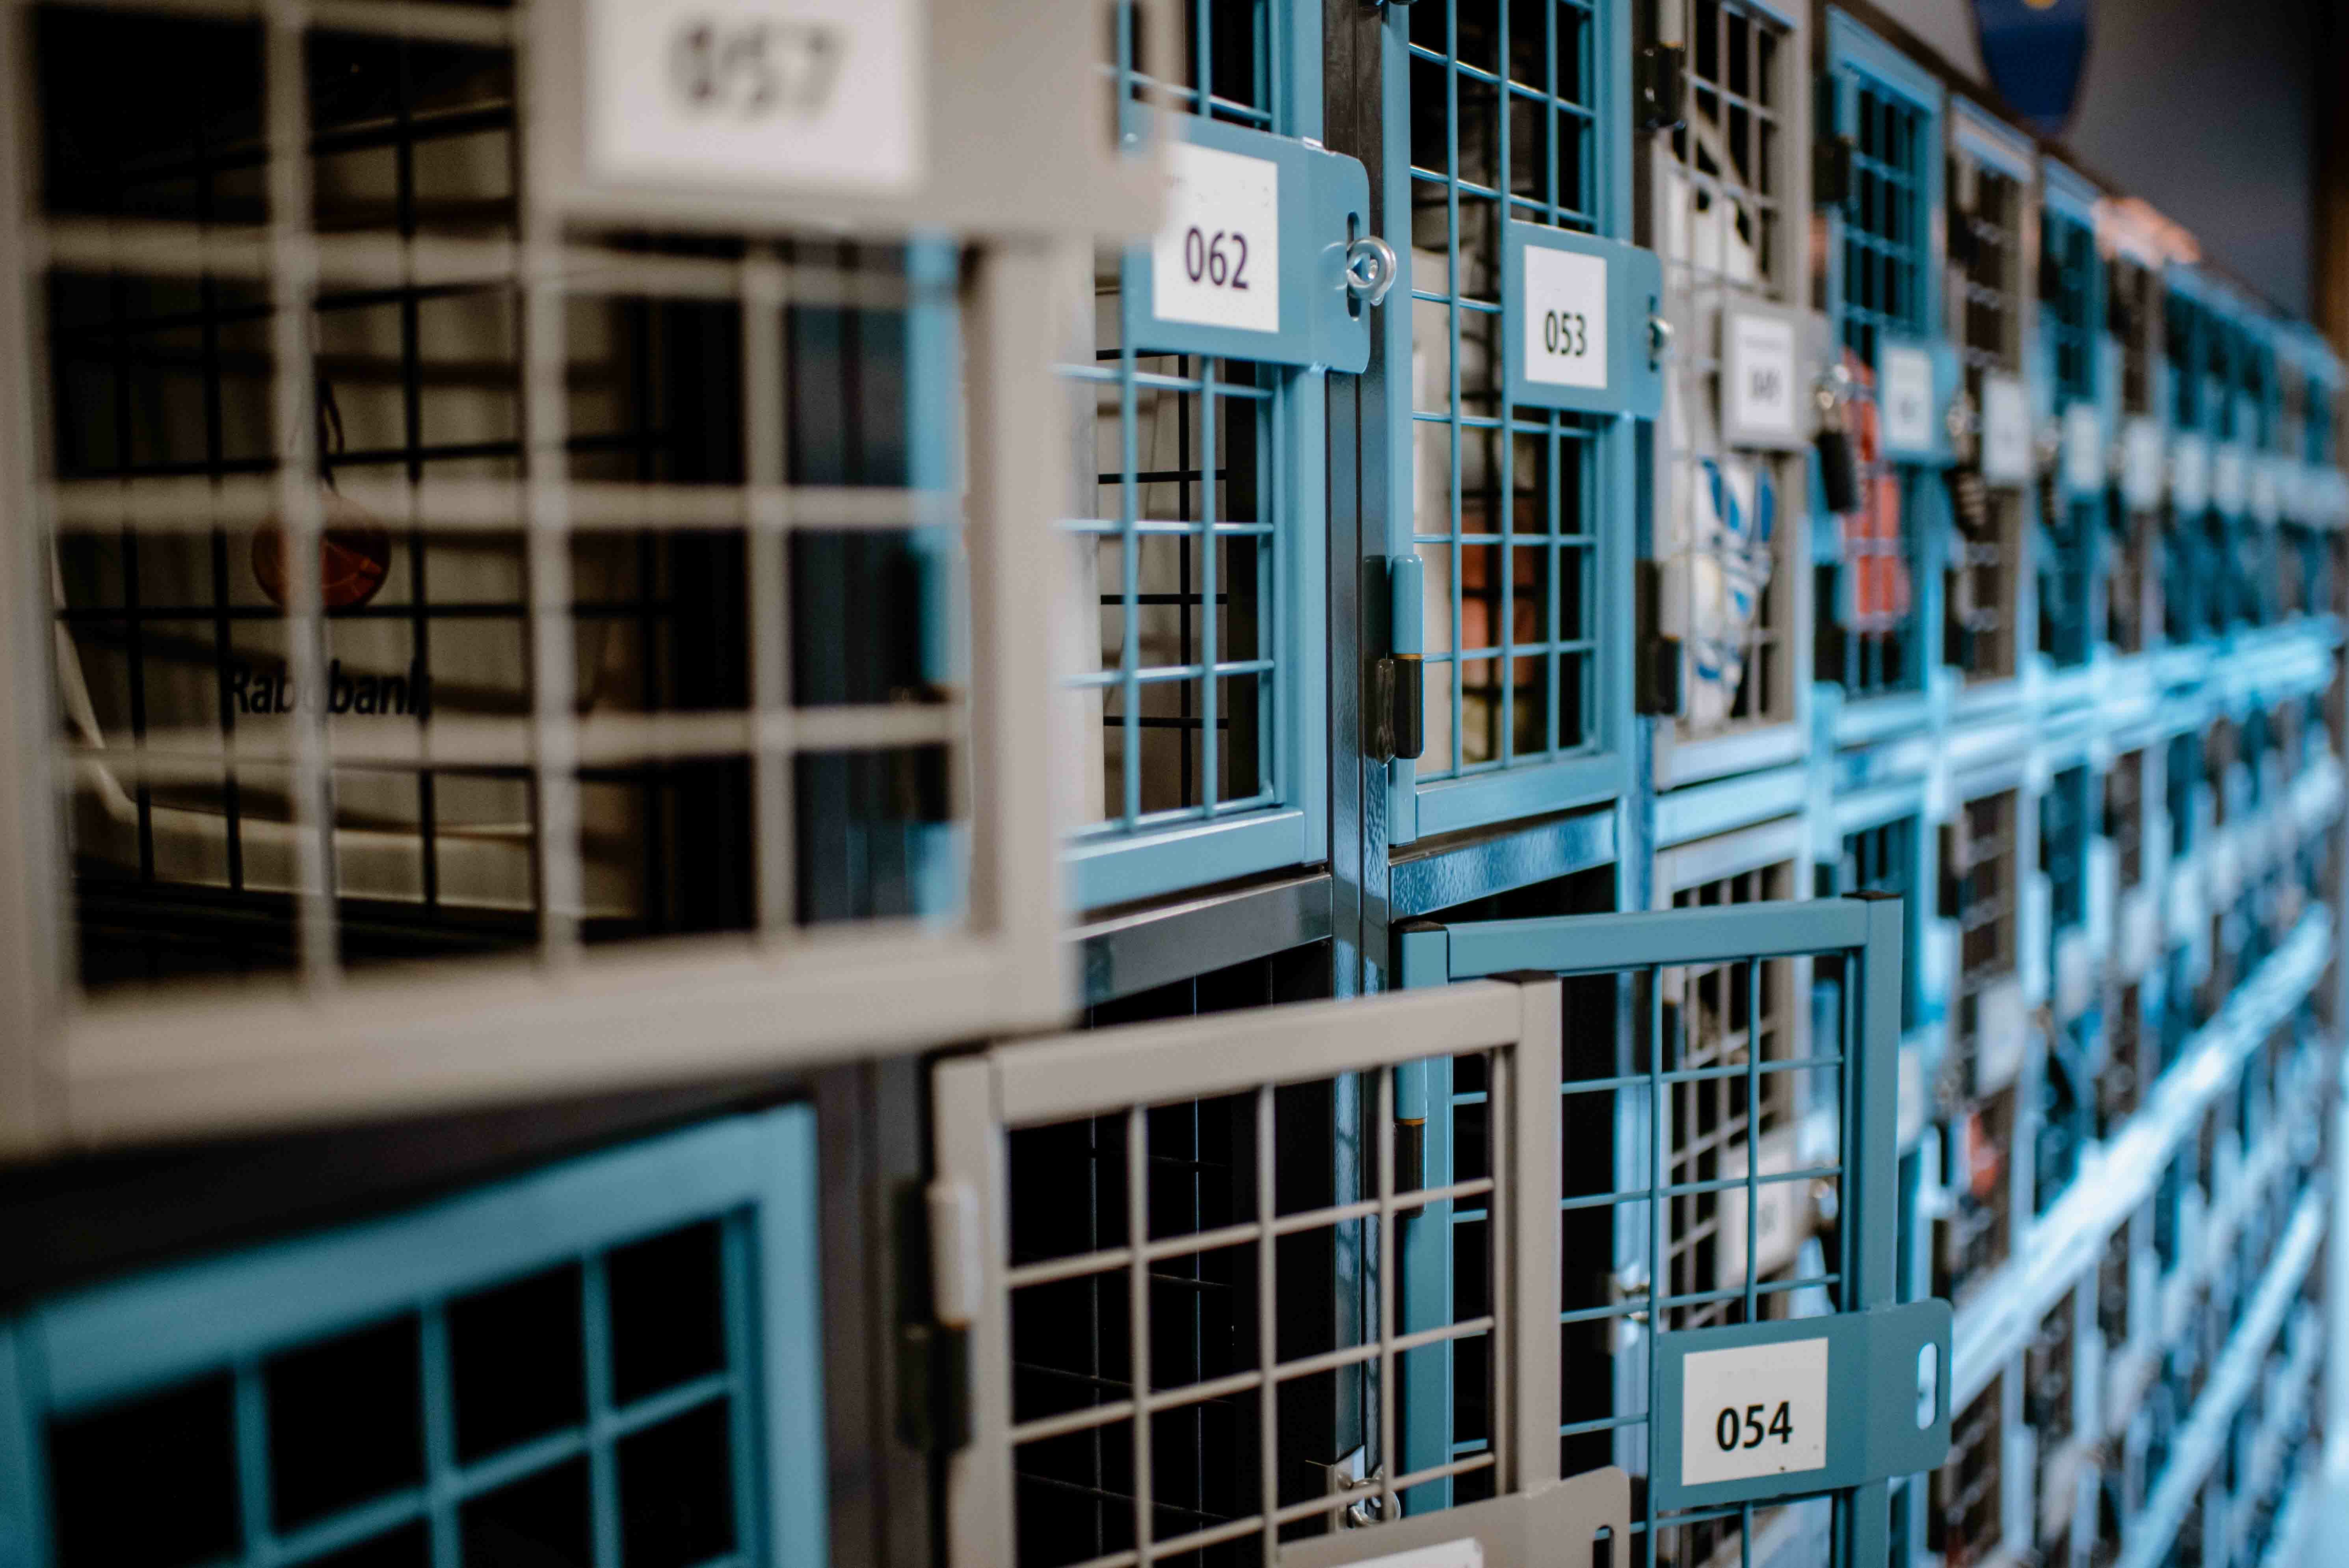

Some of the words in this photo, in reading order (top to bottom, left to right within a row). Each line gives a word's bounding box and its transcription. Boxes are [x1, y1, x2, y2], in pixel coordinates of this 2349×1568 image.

[1185, 226, 1248, 290] 062
[1545, 309, 1586, 359] 053
[1715, 1401, 1794, 1452] 054
